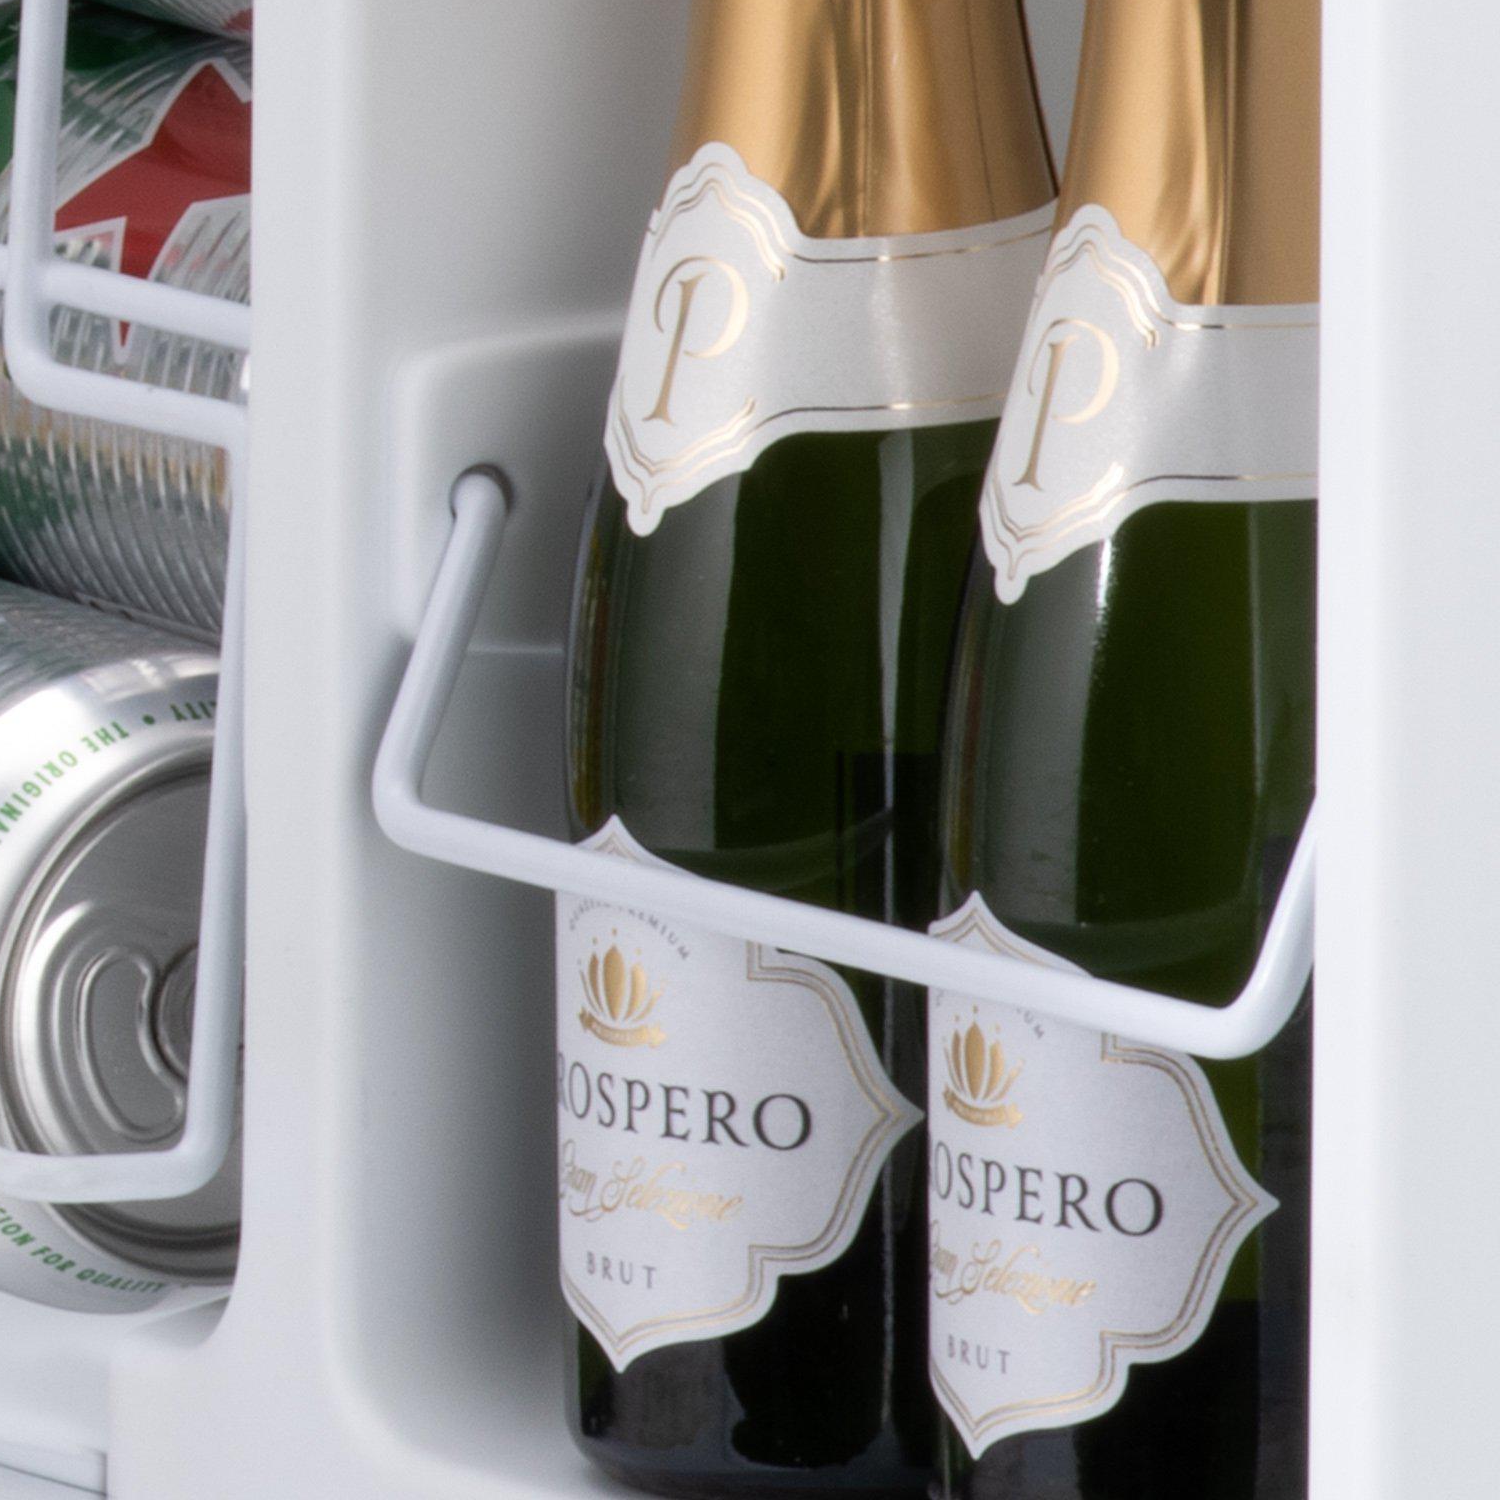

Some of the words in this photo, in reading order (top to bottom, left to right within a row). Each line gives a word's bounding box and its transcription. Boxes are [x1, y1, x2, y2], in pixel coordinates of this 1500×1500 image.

[641, 253, 750, 425] P
[1011, 316, 1120, 493] P
[81, 720, 130, 753] THE
[30, 1245, 77, 1274] FOR
[75, 1267, 167, 1294] QUALITY
[586, 1250, 658, 1290] BRUT
[948, 1333, 1011, 1375] BRUT
